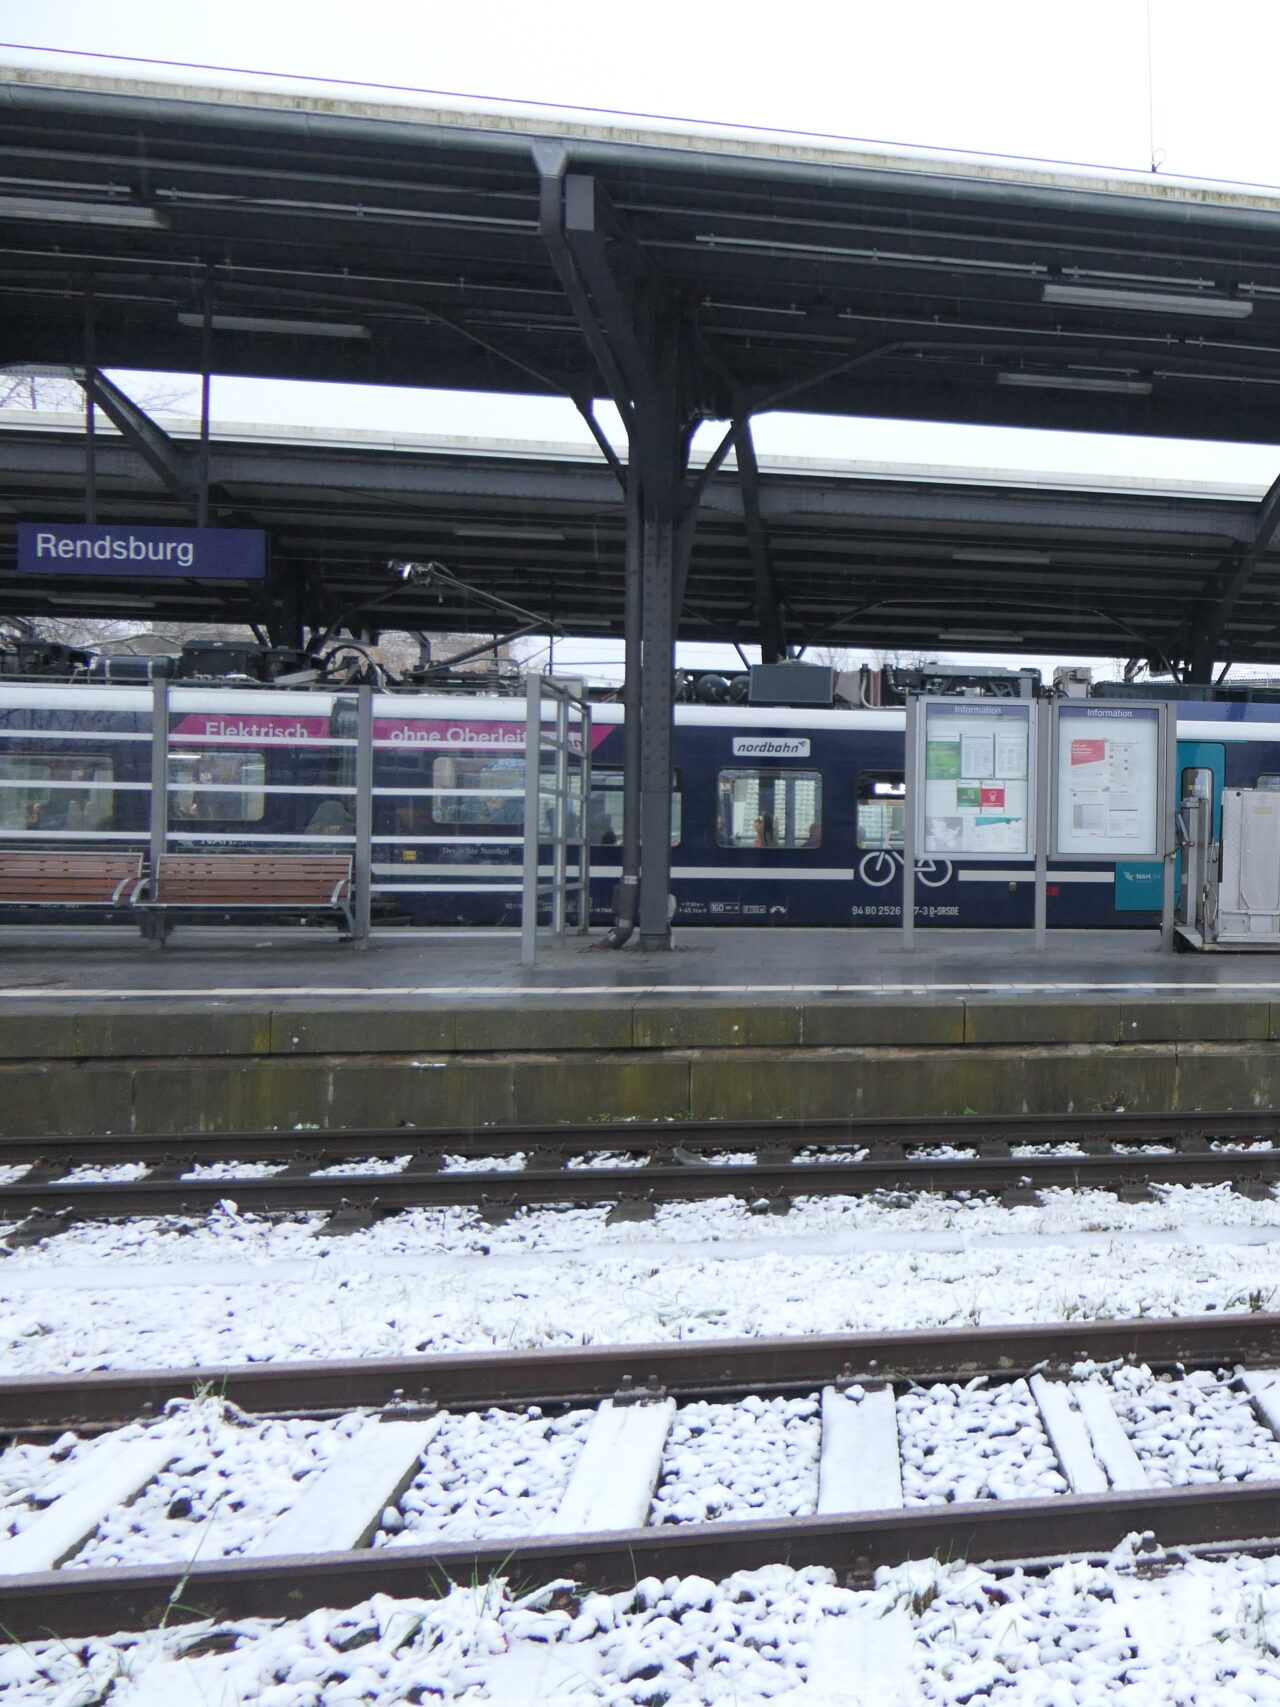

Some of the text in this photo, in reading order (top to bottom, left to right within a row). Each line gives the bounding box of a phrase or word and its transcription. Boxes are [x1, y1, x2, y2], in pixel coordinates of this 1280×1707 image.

[36, 533, 194, 567] Rendsburg
[954, 705, 1002, 715] Information
[1087, 708, 1133, 718] Information
[205, 721, 308, 738] Elektrisch
[390, 726, 441, 742] ohne
[738, 742, 799, 753] nordbahn
[852, 906, 863, 915] 94
[865, 906, 877, 915] 80
